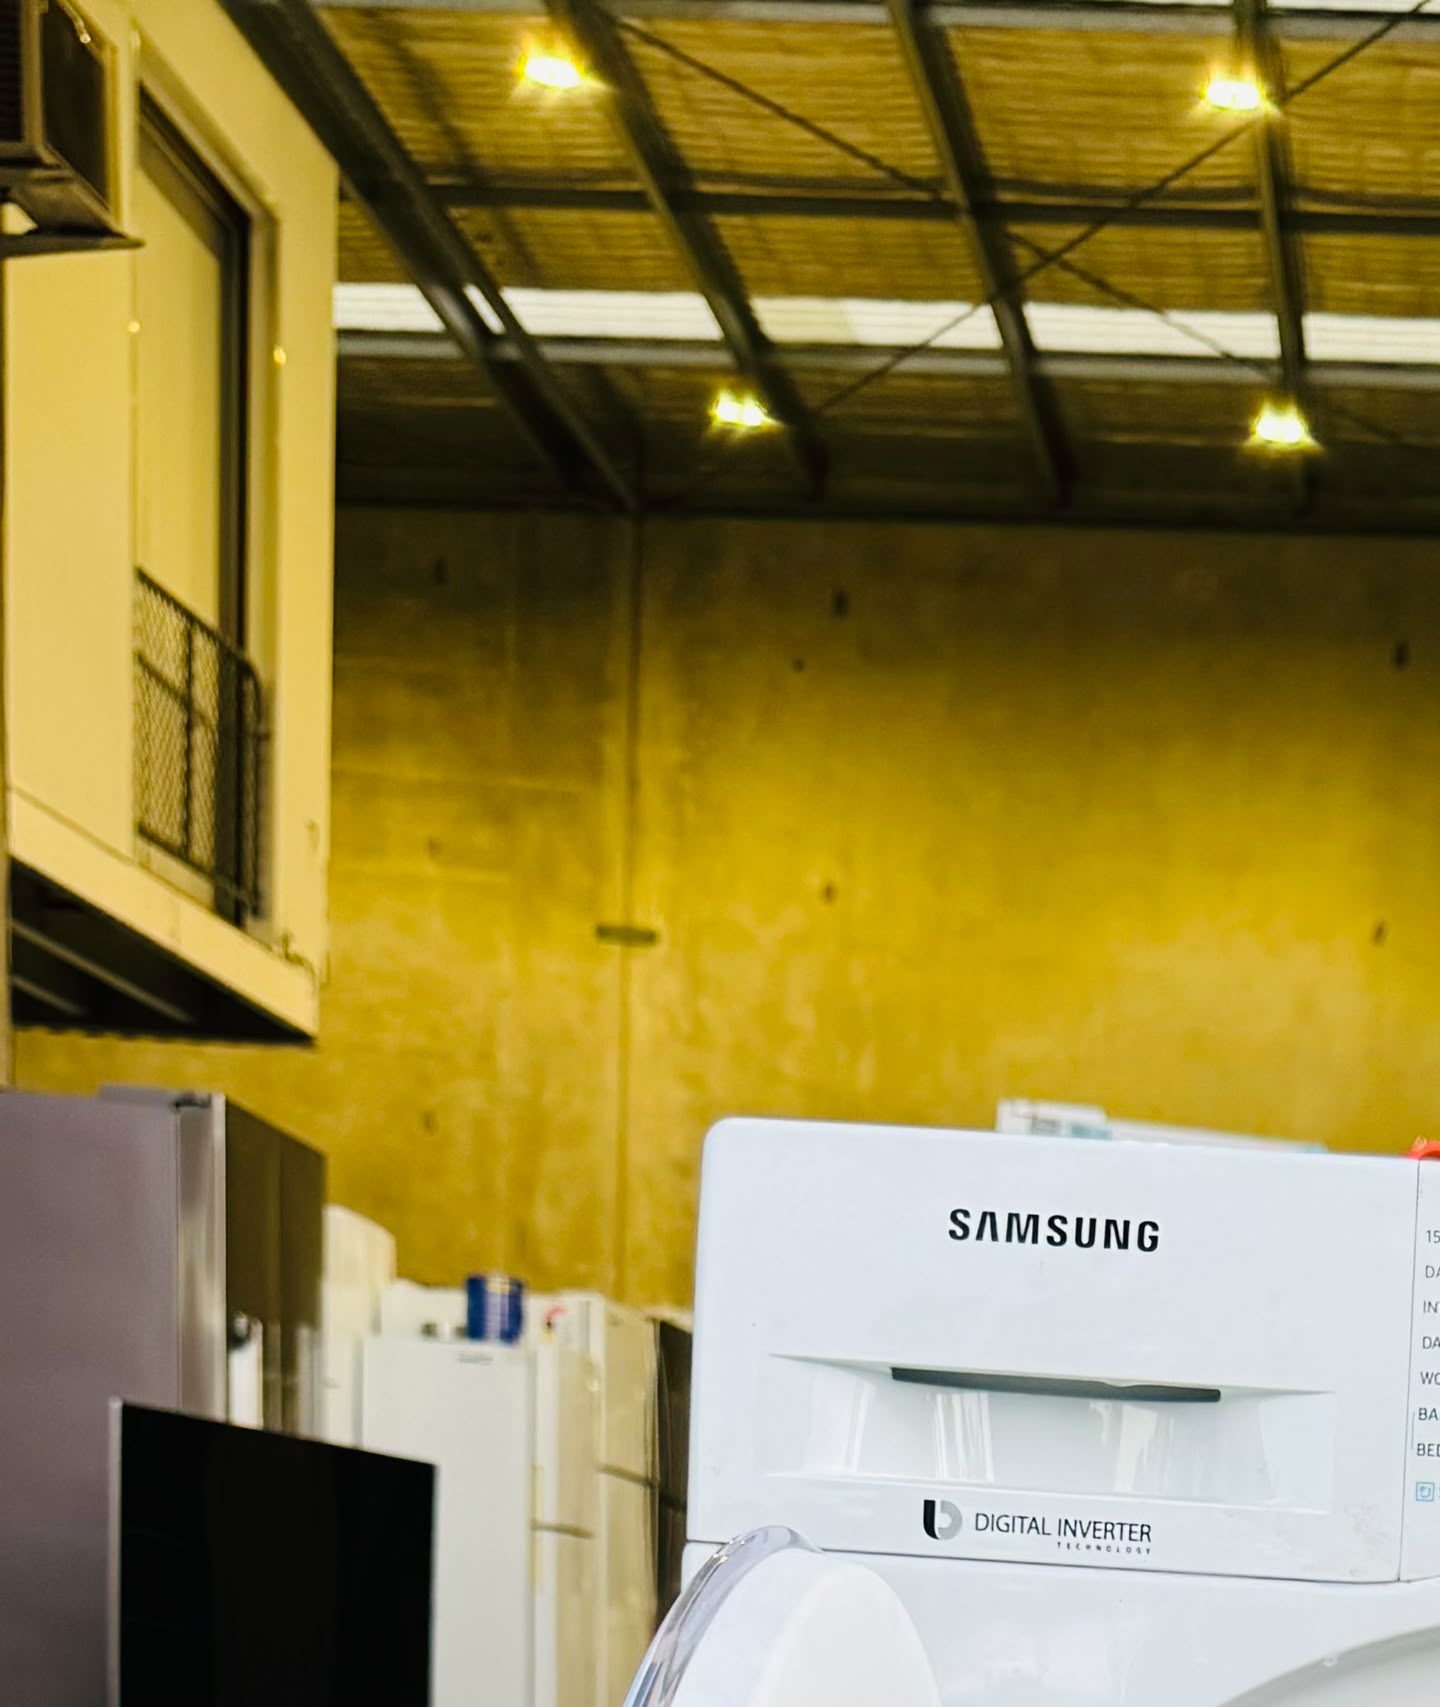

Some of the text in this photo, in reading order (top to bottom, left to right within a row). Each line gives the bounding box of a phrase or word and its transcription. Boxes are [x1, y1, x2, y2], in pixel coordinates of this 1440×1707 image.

[948, 1208, 1160, 1253] SAMSUNG
[974, 1512, 1152, 1543] DIGITAL INVERTER
[1057, 1541, 1151, 1555] TECHNOLOGY
